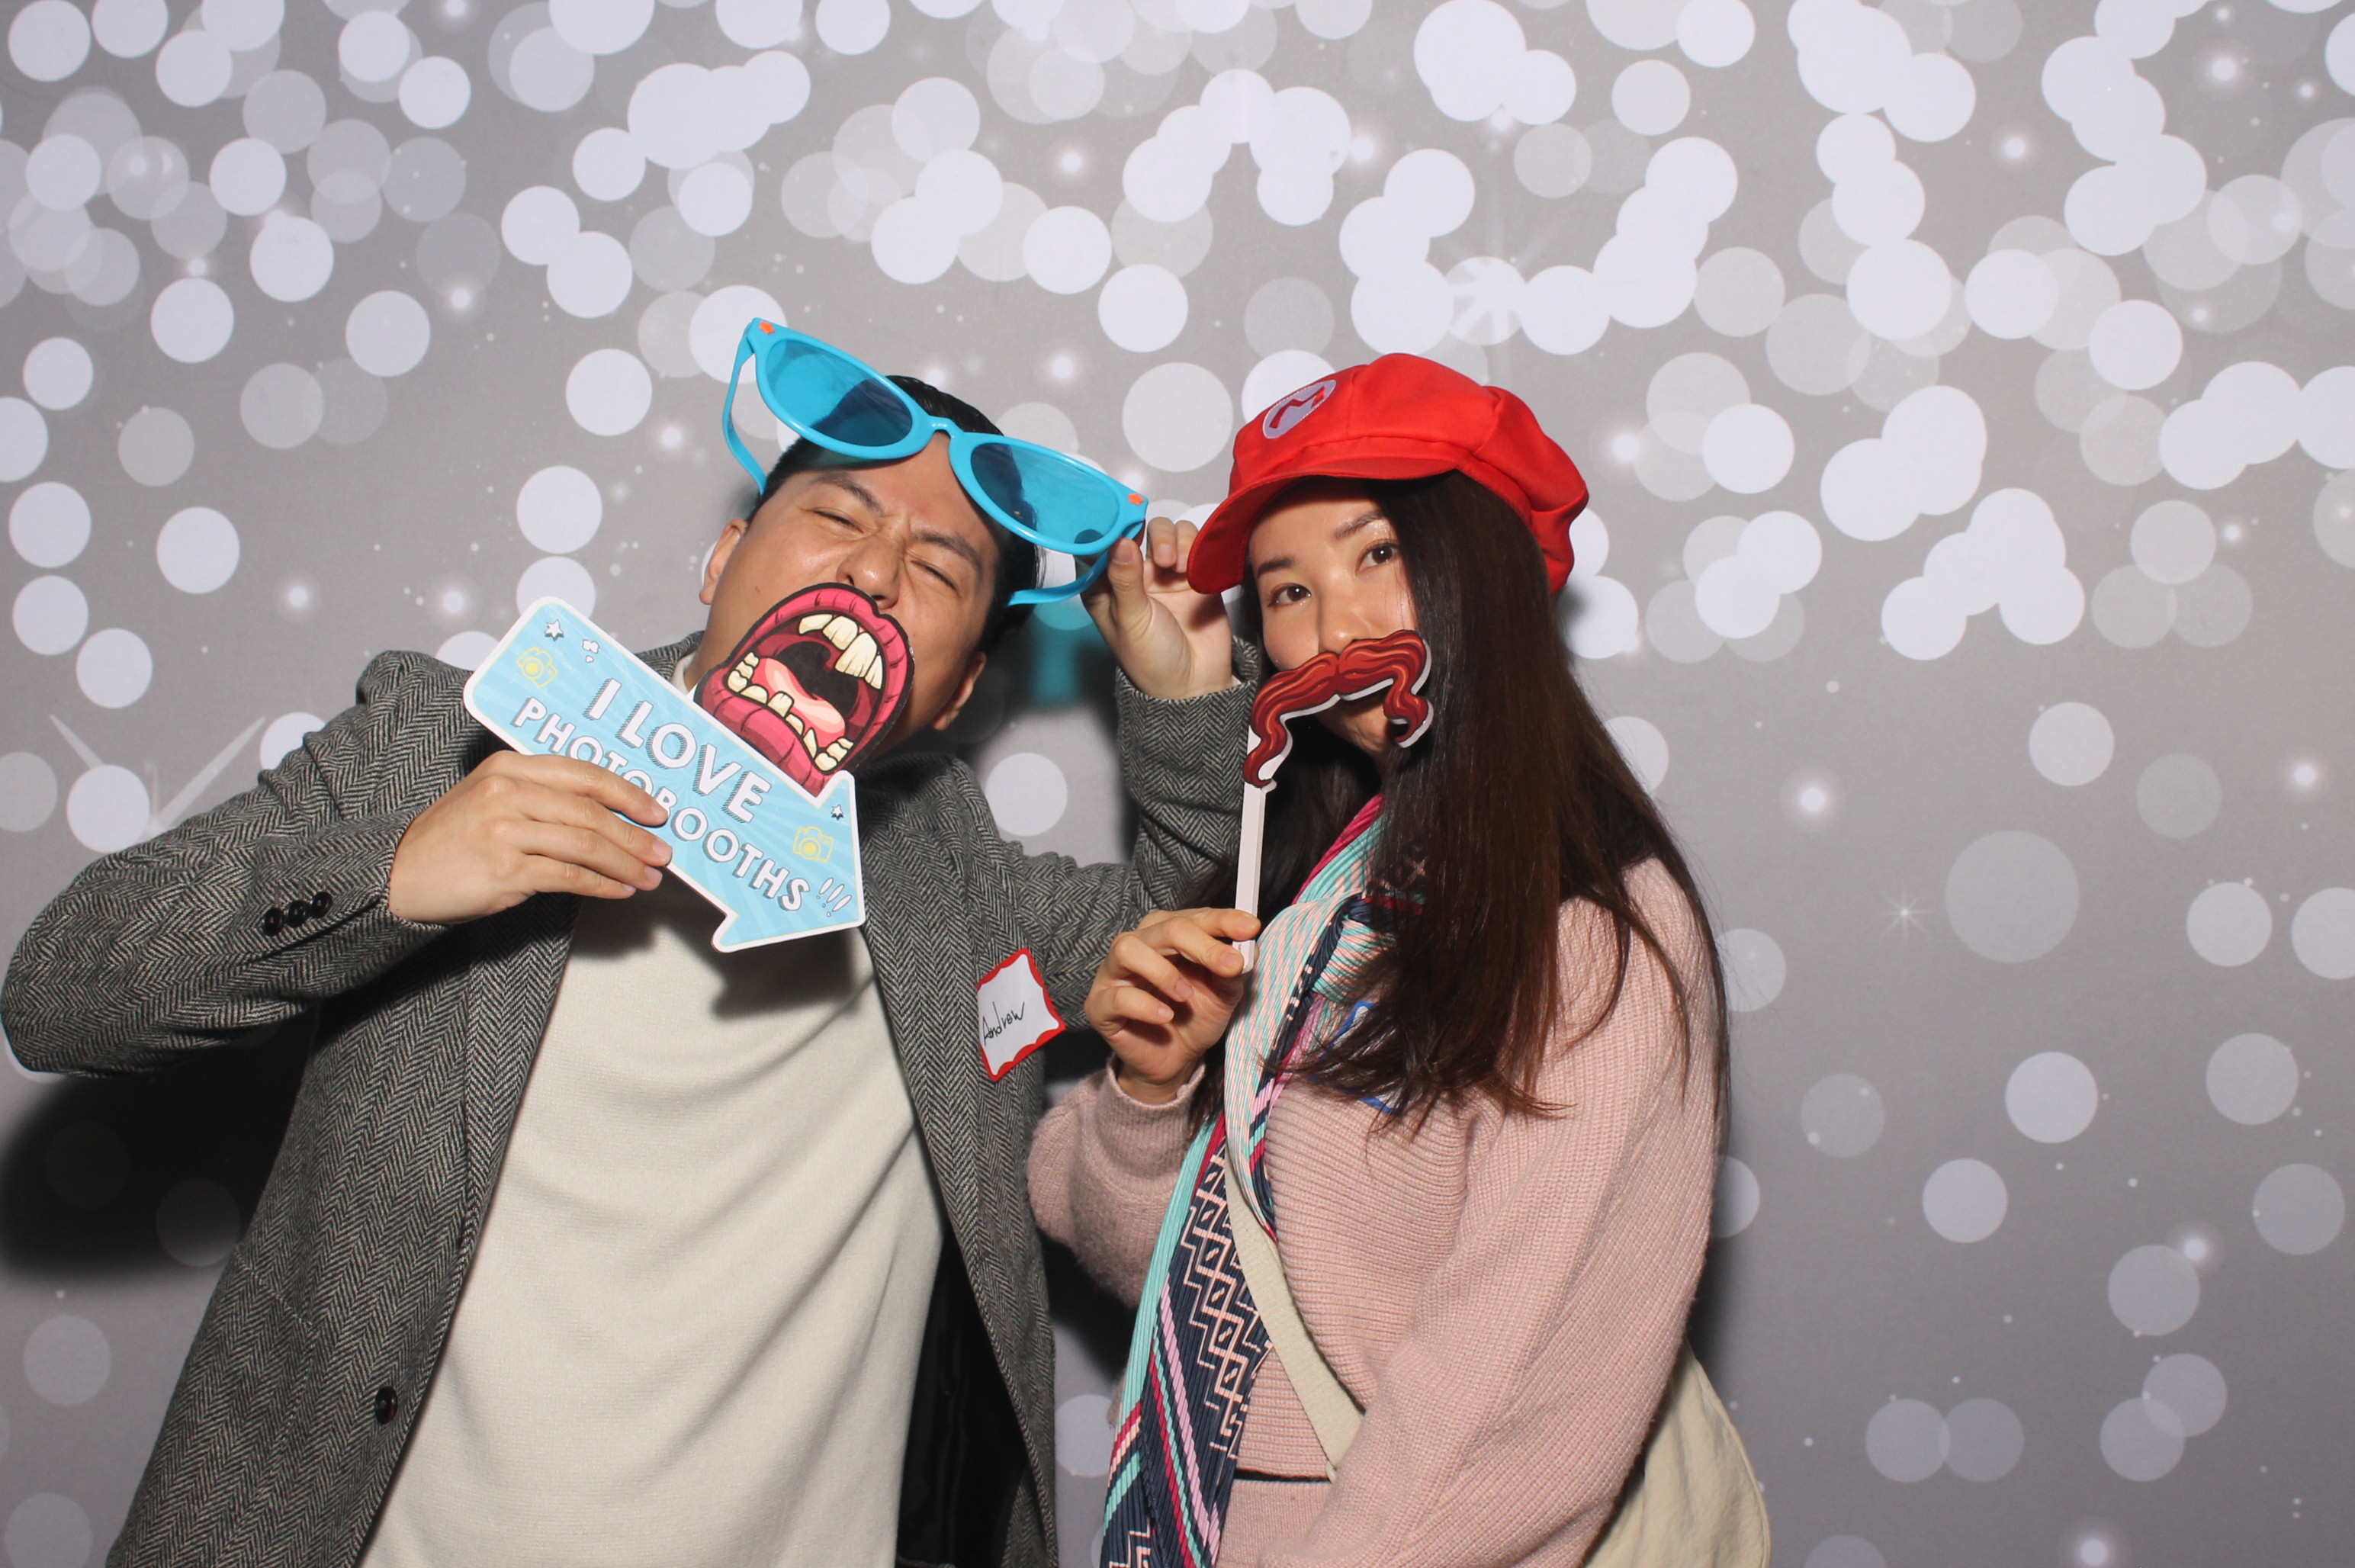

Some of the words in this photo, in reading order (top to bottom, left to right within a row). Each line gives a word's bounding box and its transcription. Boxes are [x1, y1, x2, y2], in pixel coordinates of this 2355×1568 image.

[583, 677, 622, 720] I
[615, 699, 772, 823] LOVE
[982, 1001, 1025, 1046] Andrew
